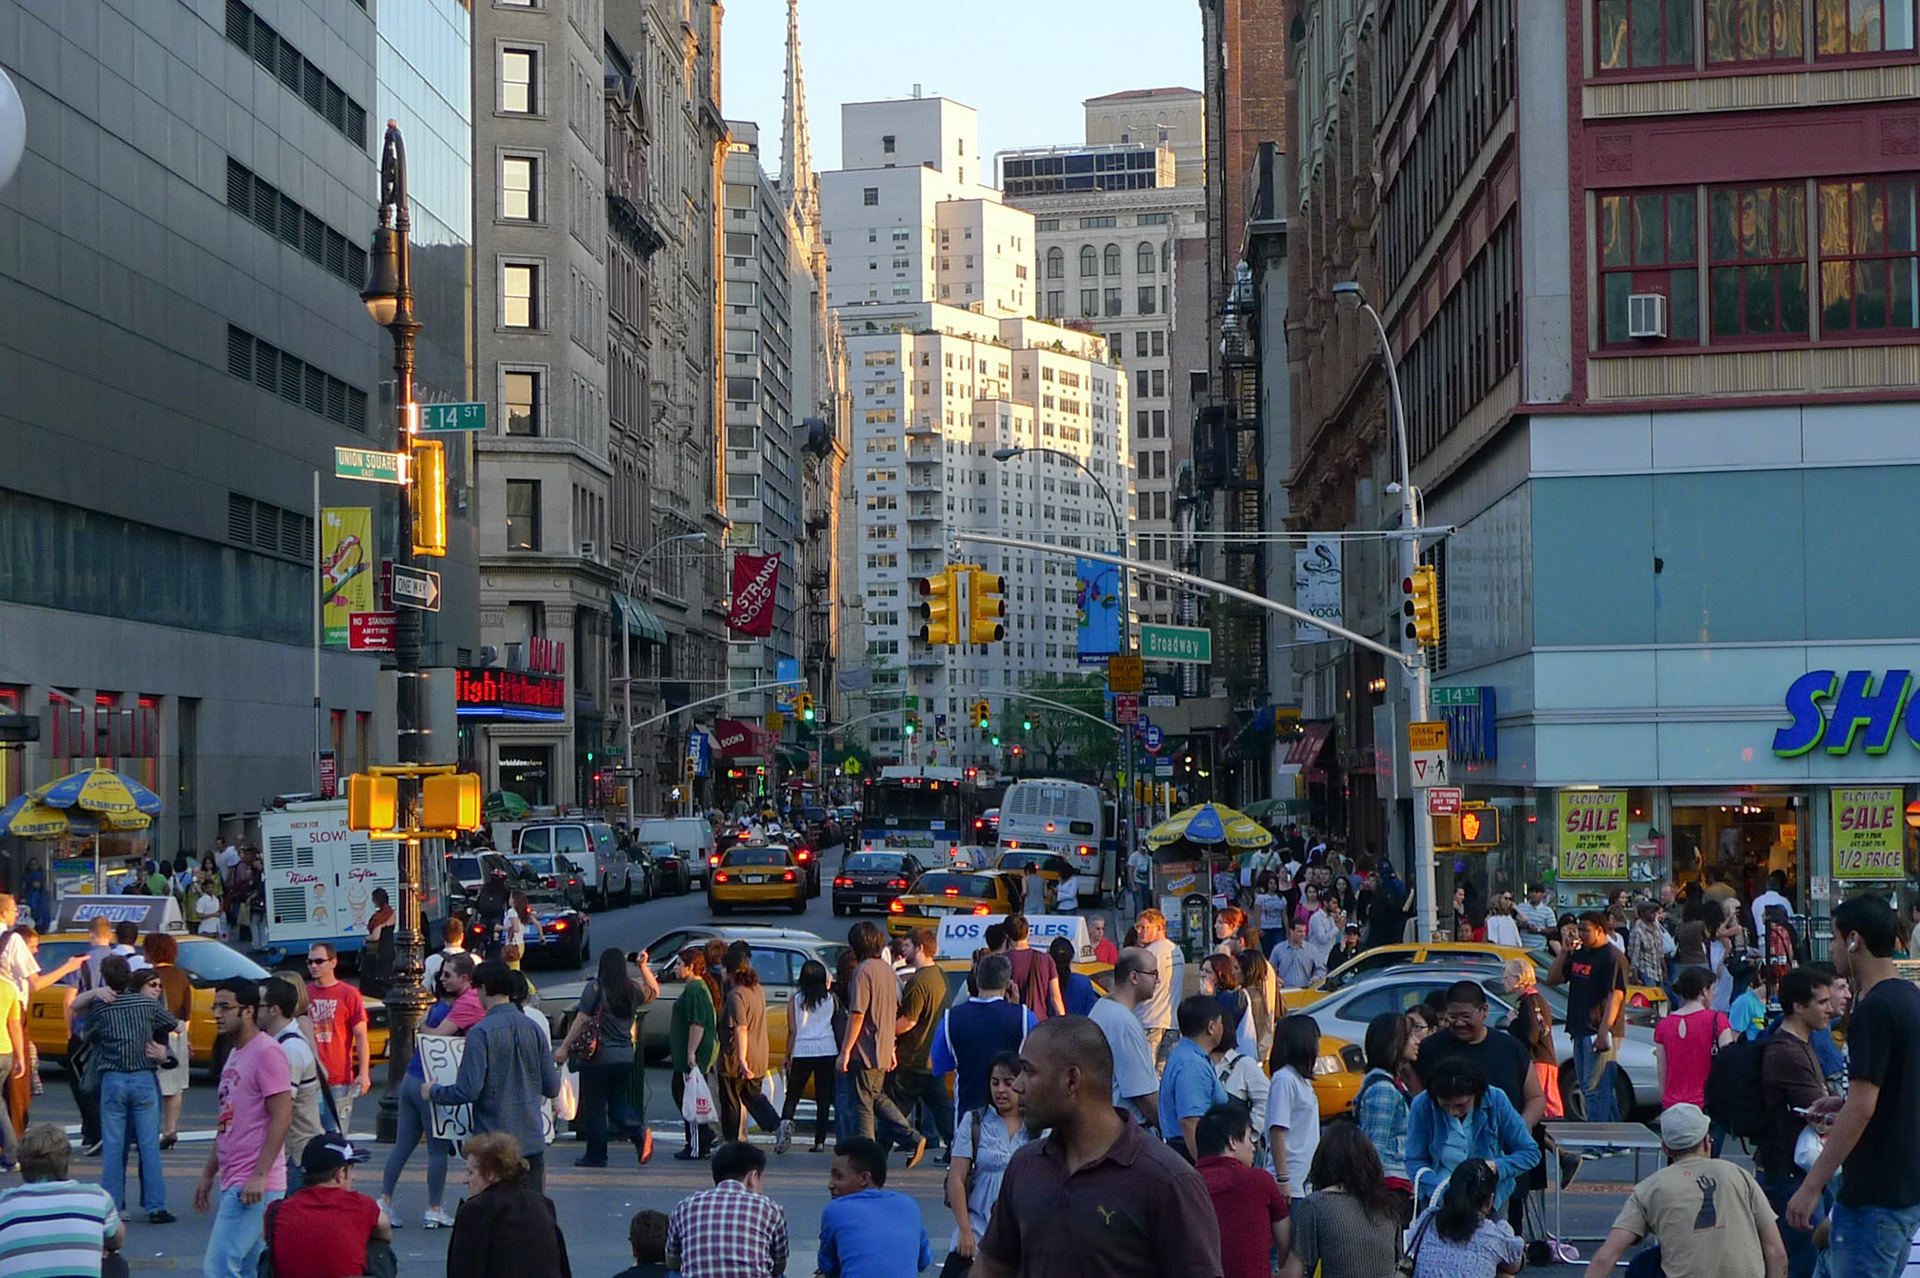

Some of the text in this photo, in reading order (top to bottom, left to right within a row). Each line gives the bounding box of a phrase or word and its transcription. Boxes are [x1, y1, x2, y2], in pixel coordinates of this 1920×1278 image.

[421, 406, 479, 428] E 14 ST
[338, 451, 397, 472] UNION SQUARE
[361, 468, 375, 477] EAST
[397, 578, 427, 596] ONE WAY
[736, 555, 779, 610] STRAND
[730, 586, 772, 628] BOOKS
[1308, 607, 1342, 618] YOGA
[352, 617, 363, 626] NO
[361, 627, 390, 635] ANYTIME
[1150, 632, 1200, 658] Broadway
[1431, 688, 1476, 703] E 14 ST
[1772, 670, 1920, 759] SH
[1410, 727, 1435, 736] TURNING
[720, 733, 745, 749] BOOKS
[1569, 794, 1617, 805] BLOWOUT
[1842, 791, 1892, 801] BLOWOUT
[82, 797, 132, 811] SABRETT
[290, 822, 308, 830] WATCH
[308, 821, 320, 829] FOR
[1566, 808, 1620, 833] SALE
[1840, 805, 1896, 831] SALE
[13, 821, 64, 834] SABRETT
[309, 830, 347, 844] SLOW!
[1564, 851, 1625, 871] 1/2 PRICE
[1839, 849, 1901, 869] 1/2 PRICE
[285, 870, 321, 884] Mister
[944, 923, 980, 938] LOS
